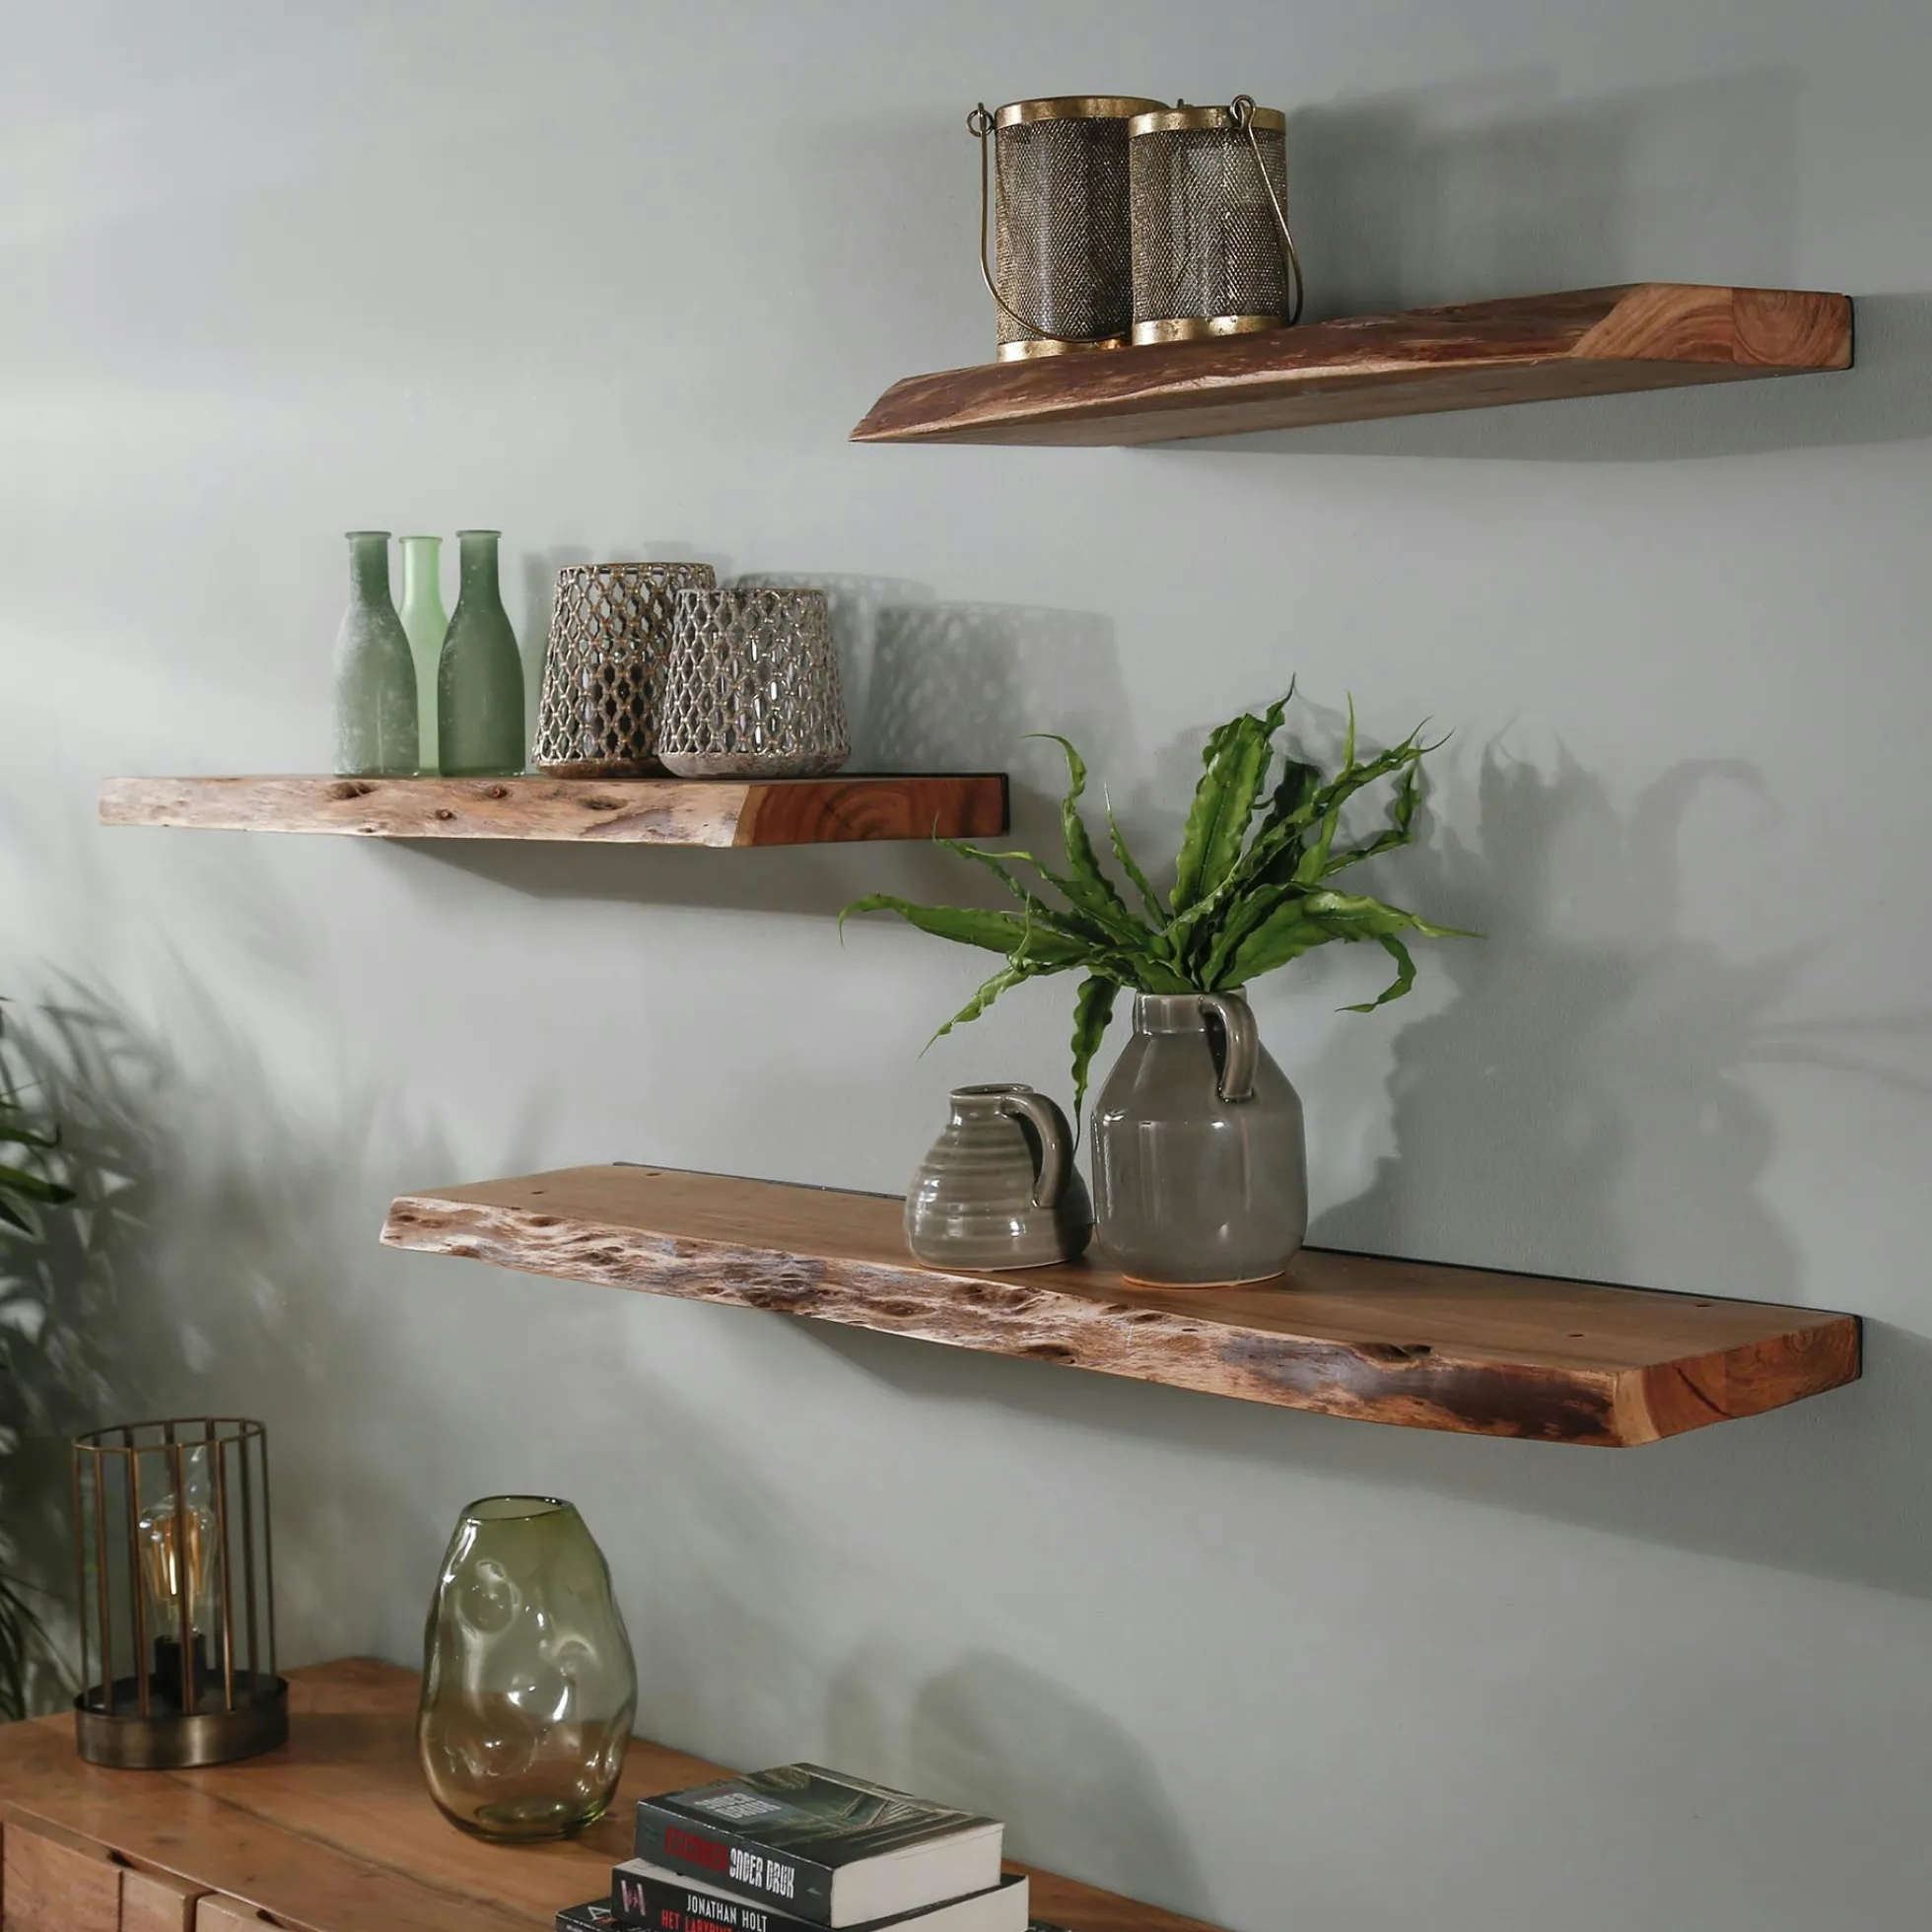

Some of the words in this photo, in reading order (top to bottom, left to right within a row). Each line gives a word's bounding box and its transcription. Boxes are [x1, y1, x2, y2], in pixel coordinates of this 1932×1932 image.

[729, 1847, 764, 1888] ONDER
[766, 1859, 795, 1899] DRUK
[661, 1908, 681, 1930] HET
[686, 1895, 737, 1925] JONATHAN
[742, 1910, 767, 1932] HOLT
